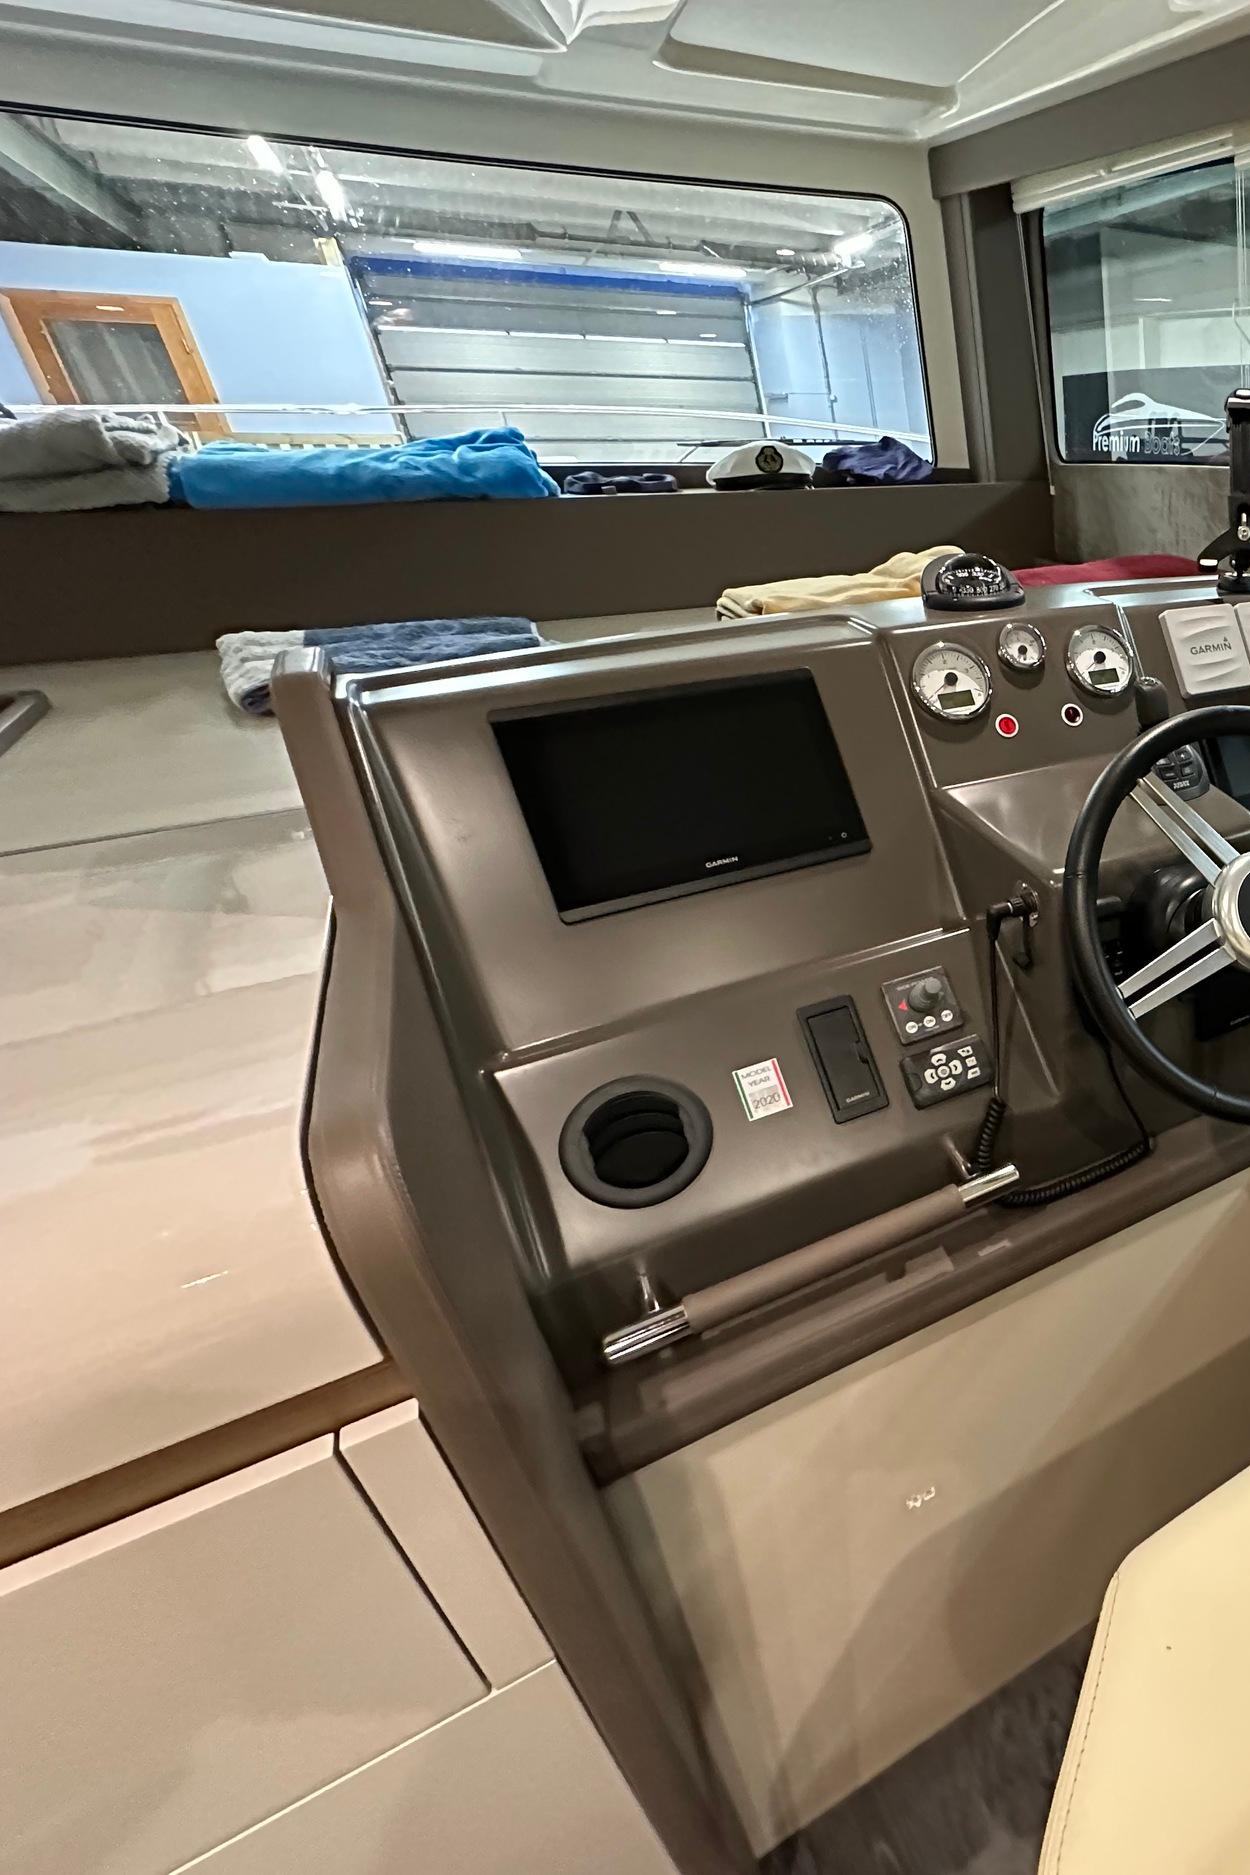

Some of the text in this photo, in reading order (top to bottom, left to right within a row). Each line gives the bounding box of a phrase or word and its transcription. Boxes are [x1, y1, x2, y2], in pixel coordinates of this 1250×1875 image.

[1092, 430, 1140, 453] Premium
[1190, 641, 1232, 655] GARMIN
[705, 855, 739, 869] GARMIN
[740, 1066, 771, 1080] MODEL
[748, 1076, 770, 1087] YEAR
[752, 1092, 781, 1109] 2020
